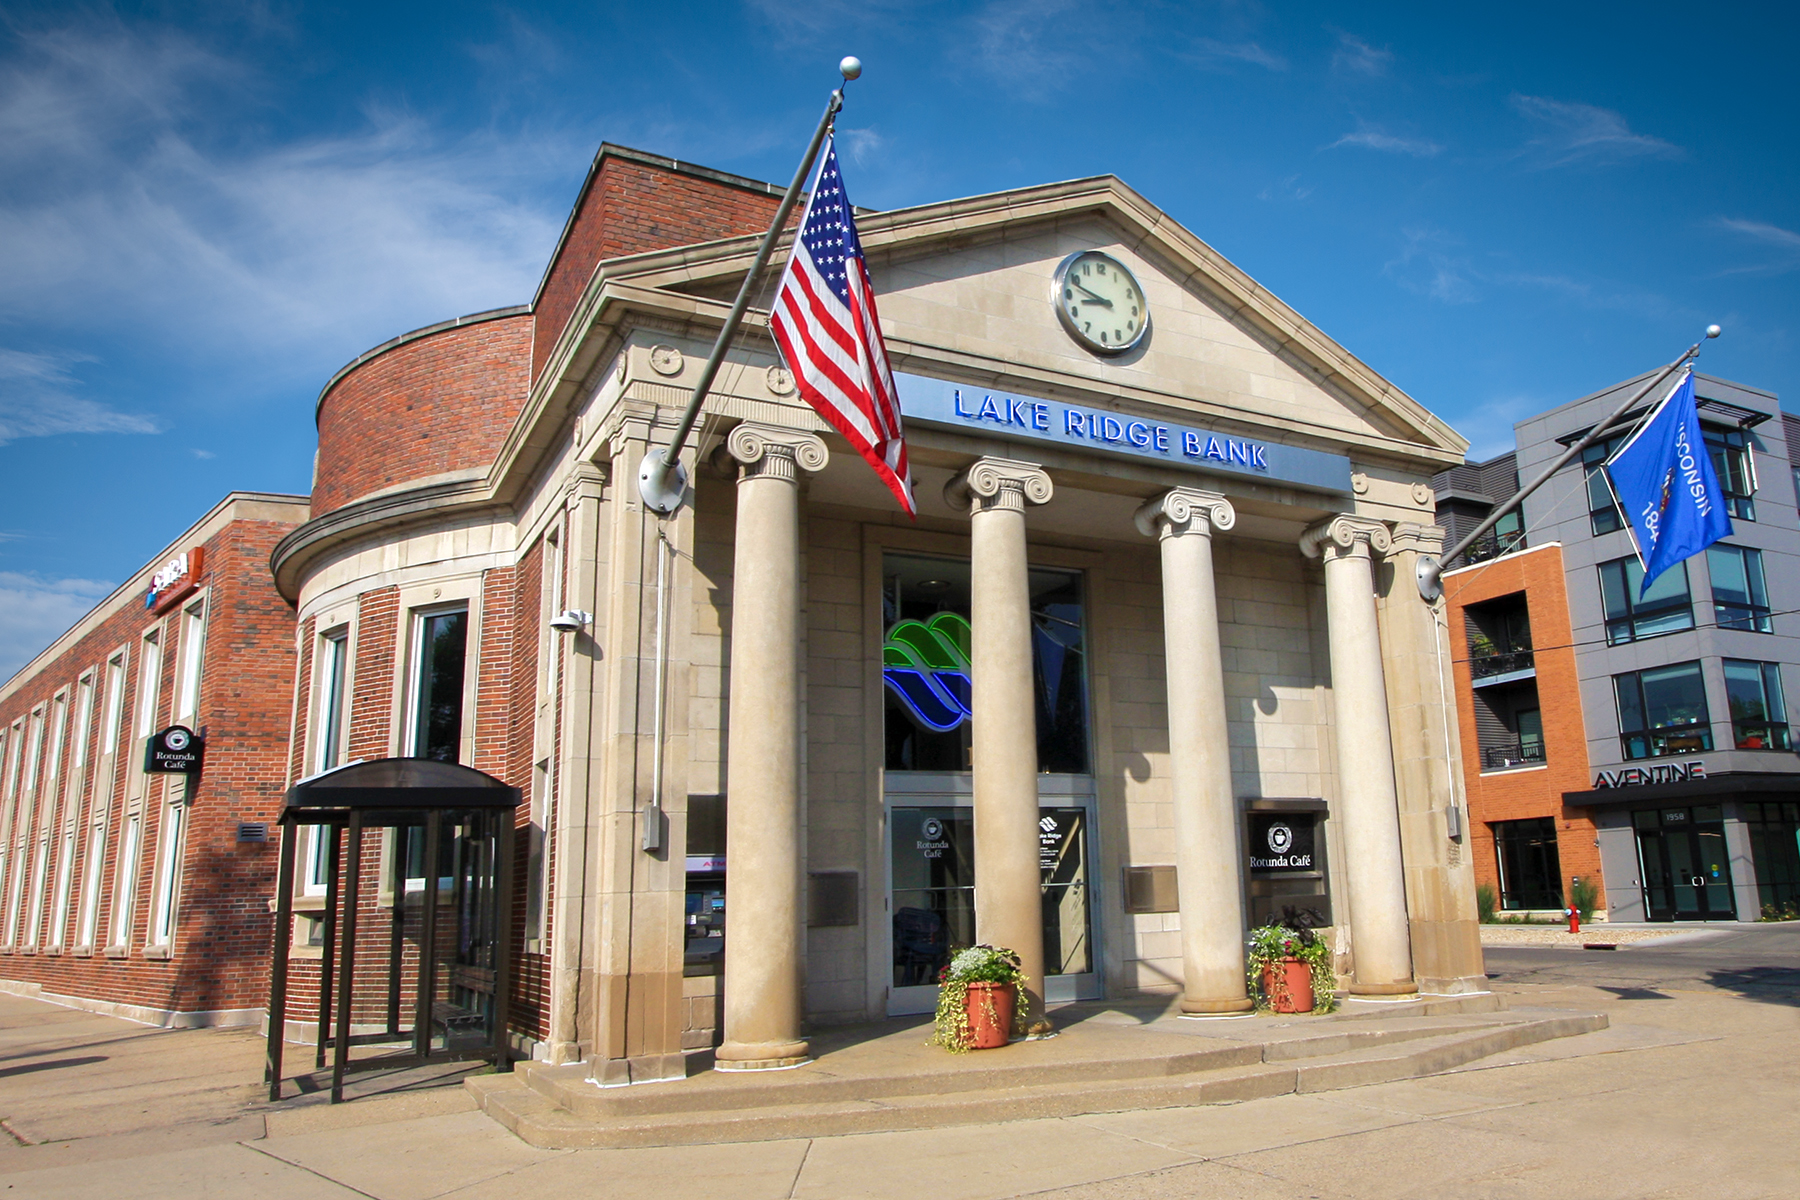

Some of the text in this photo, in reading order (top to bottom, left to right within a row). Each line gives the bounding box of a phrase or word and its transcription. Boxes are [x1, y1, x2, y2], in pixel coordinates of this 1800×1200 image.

[1083, 264, 1091, 277] 11
[1097, 263, 1106, 276] 12
[1114, 272, 1118, 283] 1
[1127, 288, 1133, 300] 2
[1132, 306, 1138, 317] 3
[1085, 322, 1091, 334] 7
[954, 389, 1268, 470] LAKE RIDGE BANK
[1641, 500, 1661, 551] 184
[156, 751, 196, 760] Rotunda
[164, 760, 186, 769] Café
[1591, 760, 1707, 790] AVENTINE
[1665, 812, 1685, 821] 1958
[916, 840, 949, 849] Rotunda
[924, 849, 942, 858] Café
[1249, 854, 1311, 868] Rotunda Café
